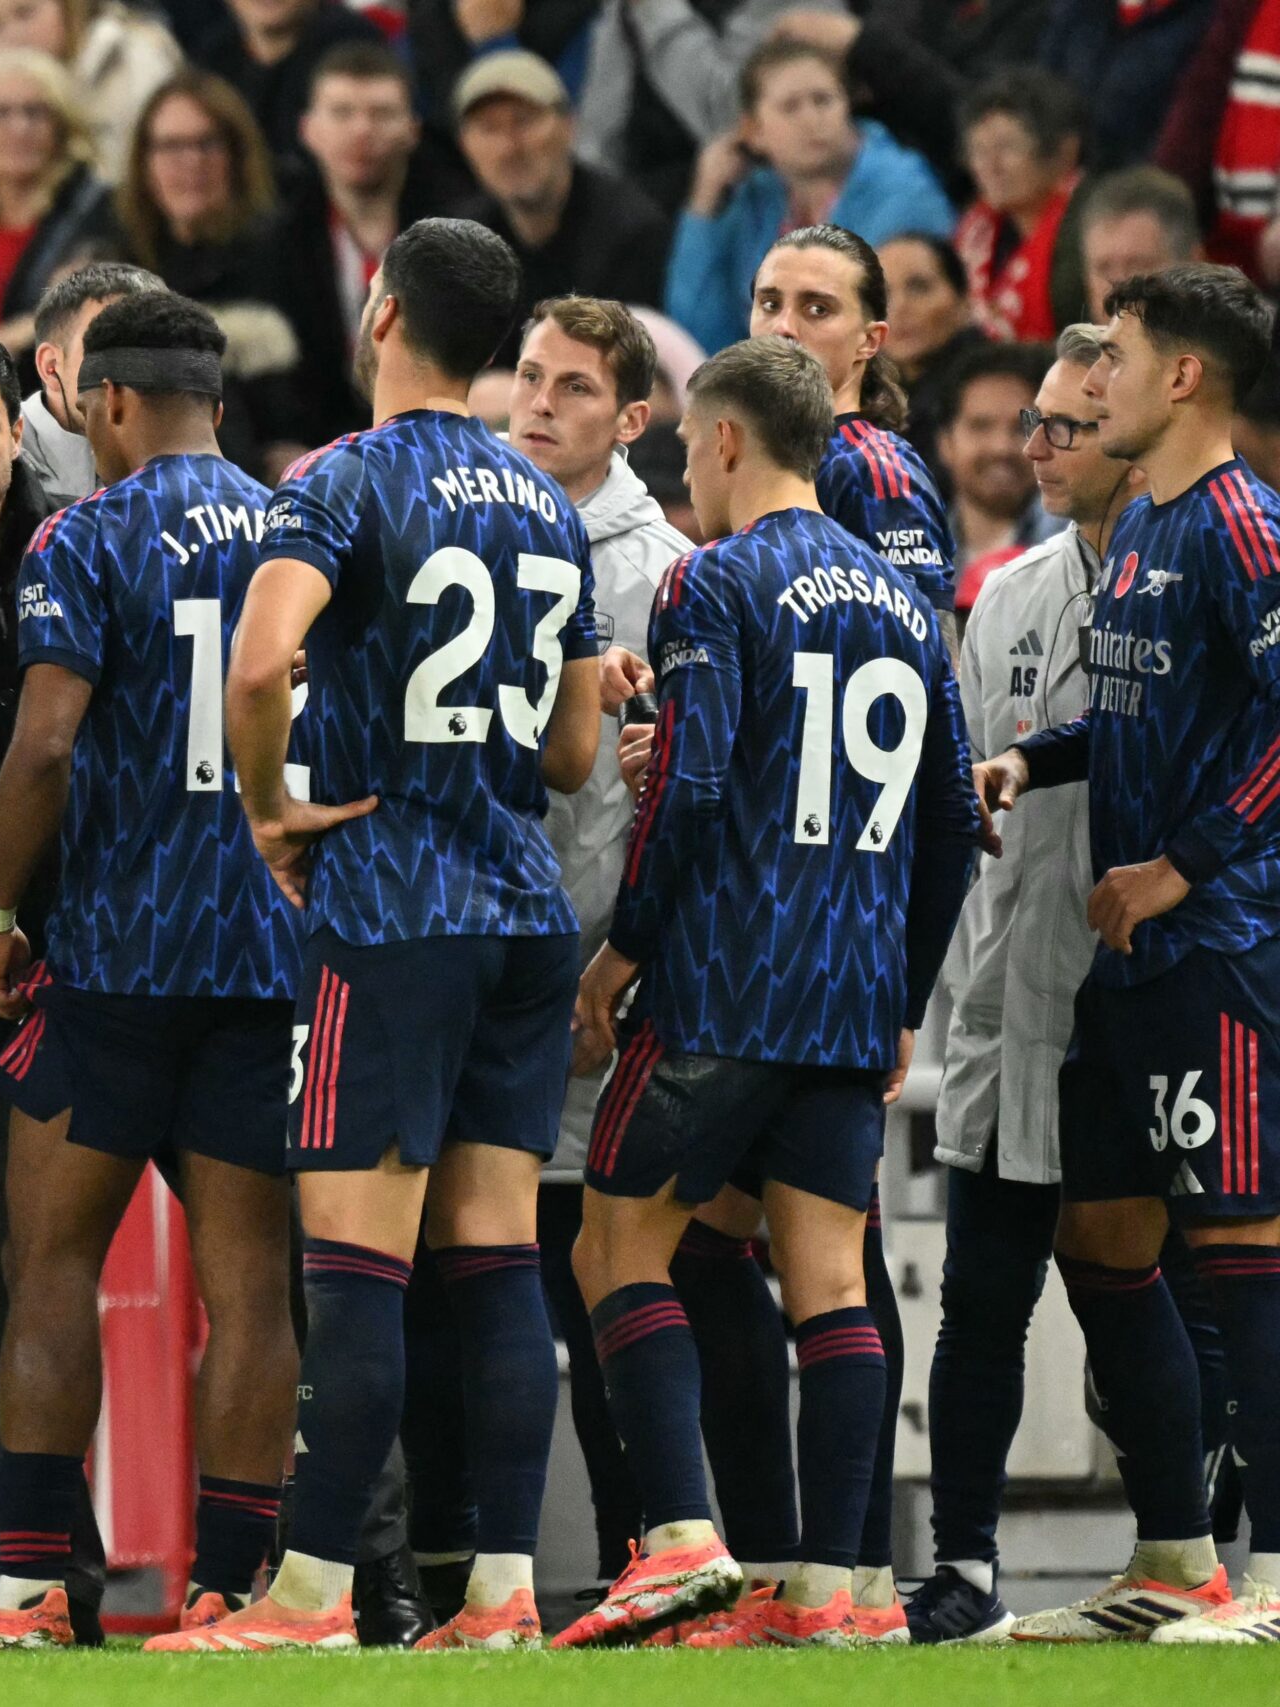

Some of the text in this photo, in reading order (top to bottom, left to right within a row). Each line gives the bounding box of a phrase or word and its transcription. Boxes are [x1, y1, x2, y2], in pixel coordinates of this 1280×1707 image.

[432, 467, 557, 523] MERINO
[876, 529, 924, 547] VISIT
[879, 548, 944, 565] ANDA
[777, 566, 927, 641] TROSSARD
[405, 546, 581, 750] 23
[1009, 666, 1038, 697] AS
[793, 652, 927, 852] 19
[1149, 1070, 1216, 1151] 36
